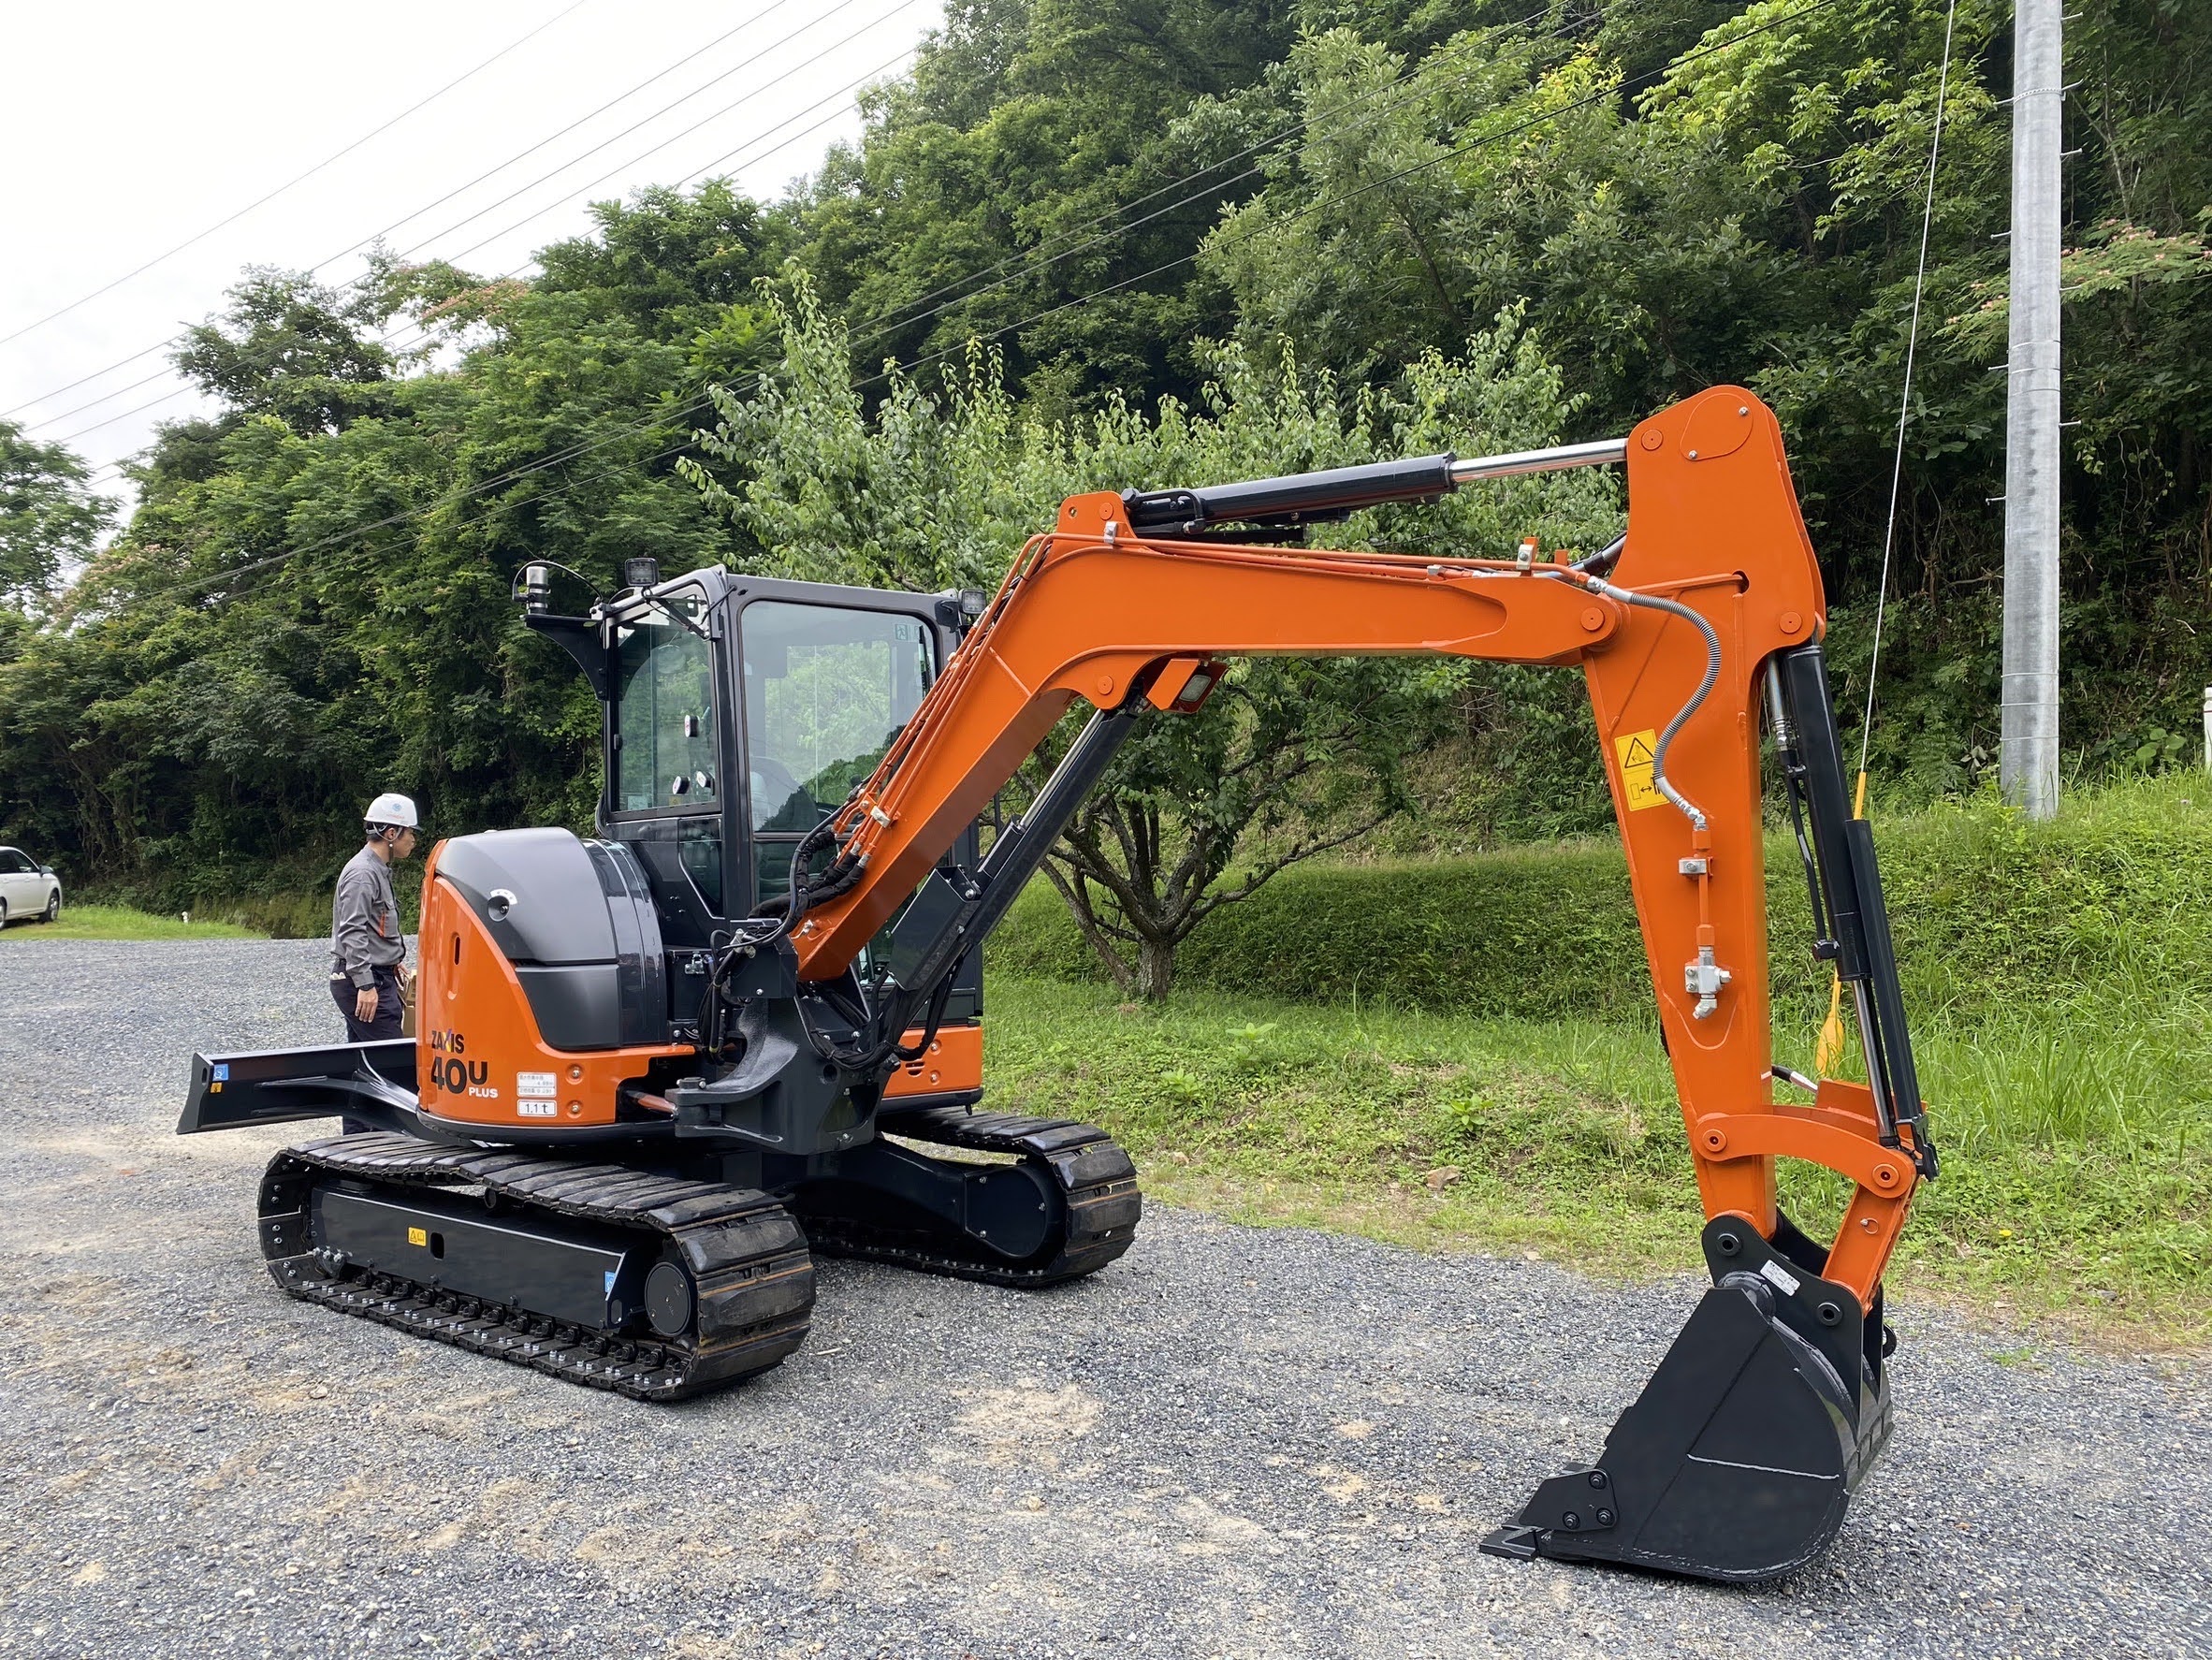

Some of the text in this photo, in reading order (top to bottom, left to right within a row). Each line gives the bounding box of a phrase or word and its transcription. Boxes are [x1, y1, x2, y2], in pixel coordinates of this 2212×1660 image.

[431, 1028, 465, 1055] ZAXIS
[430, 1056, 488, 1094] 40U
[468, 1086, 499, 1099] PLUS
